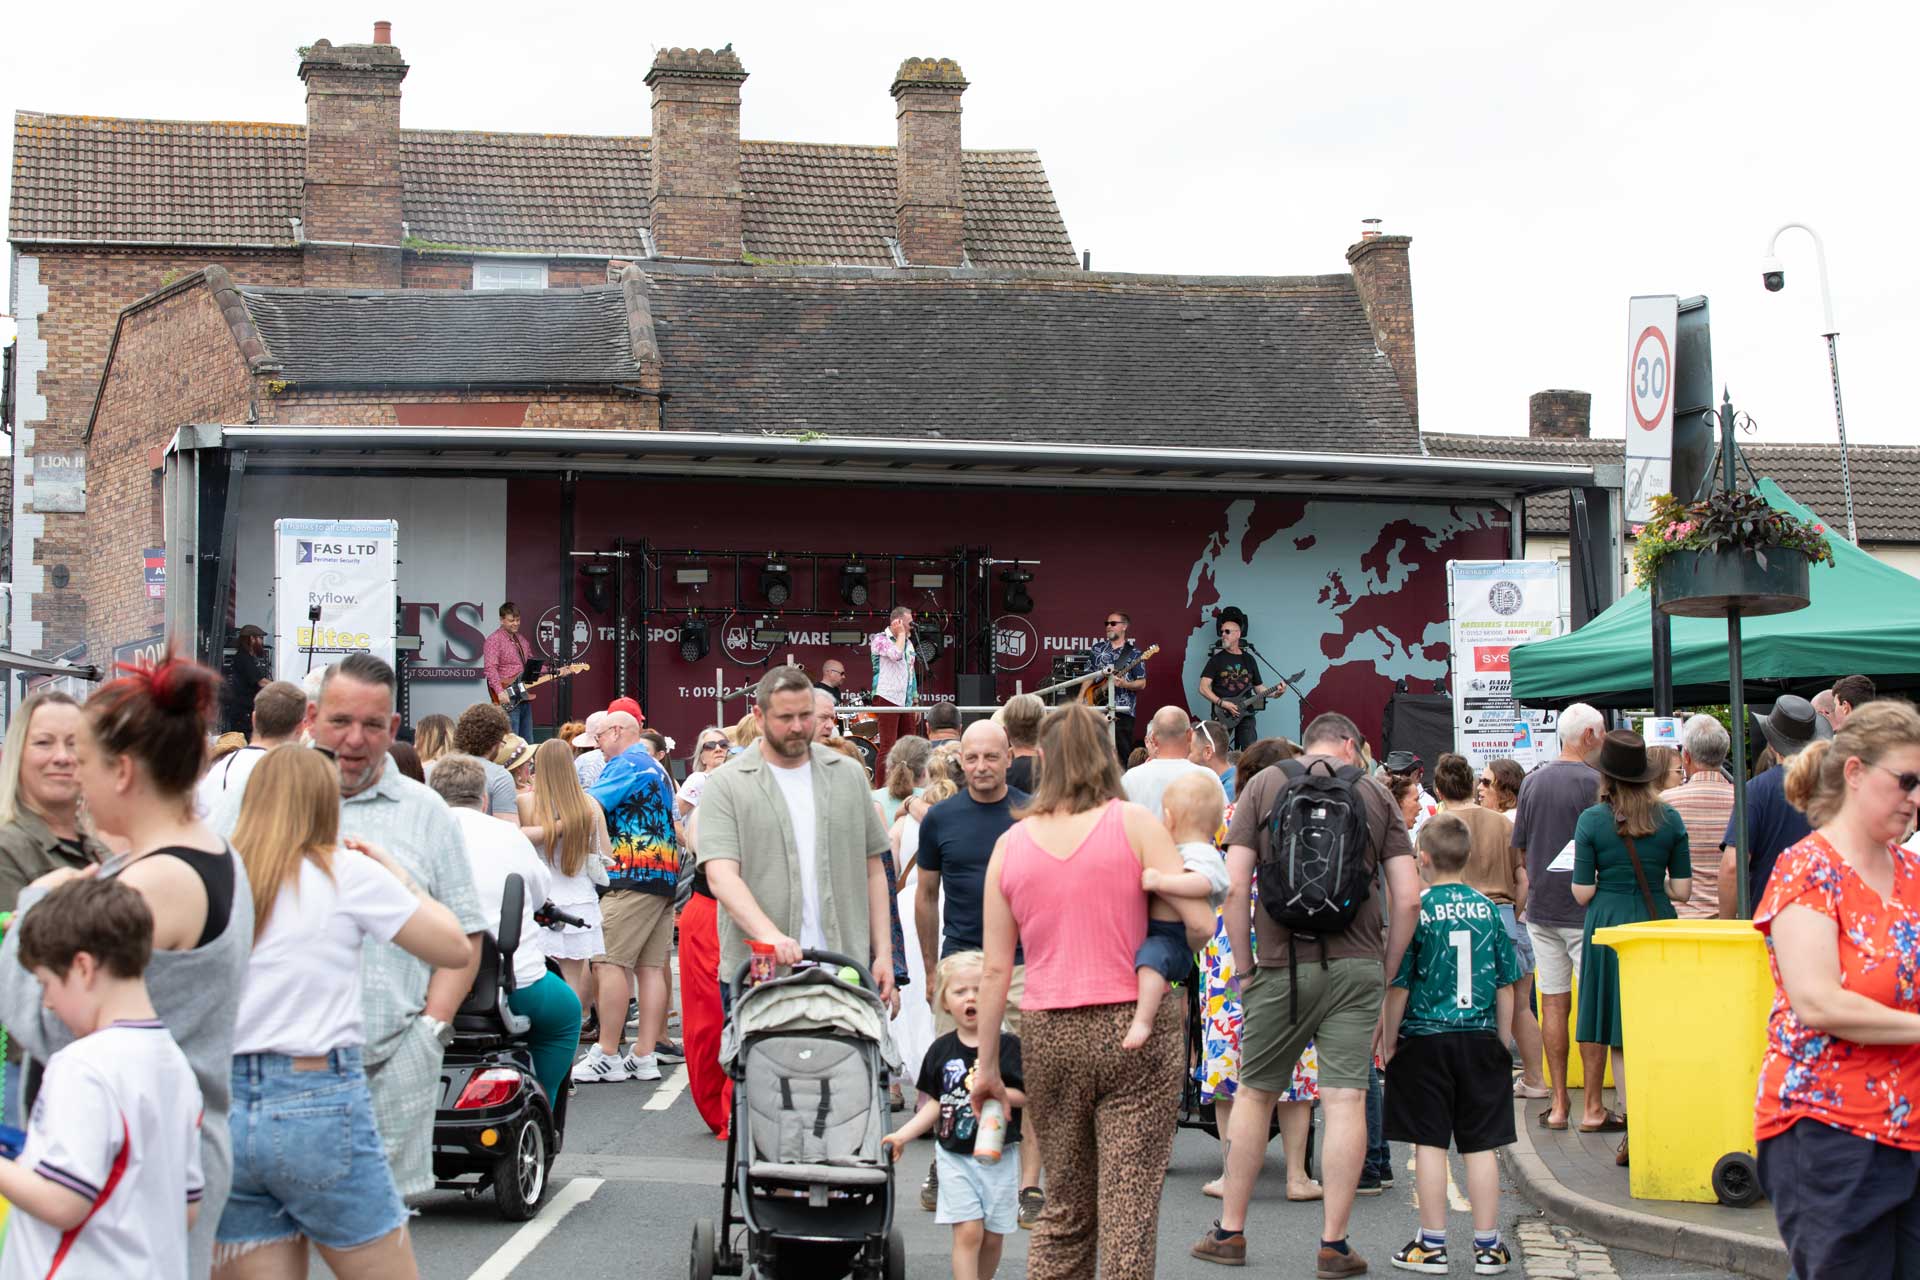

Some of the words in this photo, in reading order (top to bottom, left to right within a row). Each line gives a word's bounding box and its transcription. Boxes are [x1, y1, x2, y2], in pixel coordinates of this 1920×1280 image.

[1636, 356, 1665, 399] 30
[41, 456, 70, 468] LION
[75, 456, 86, 468] H
[314, 543, 342, 555] FAS
[348, 544, 376, 556] LTD
[296, 626, 370, 648] Bitec
[1482, 653, 1510, 664] SYS
[417, 669, 461, 677] SOLUTIONS
[462, 669, 476, 677] LTD
[678, 687, 689, 697] T:
[692, 686, 731, 697] 0192
[1472, 740, 1509, 748] RICHARD
[1449, 929, 1472, 1009] 1
